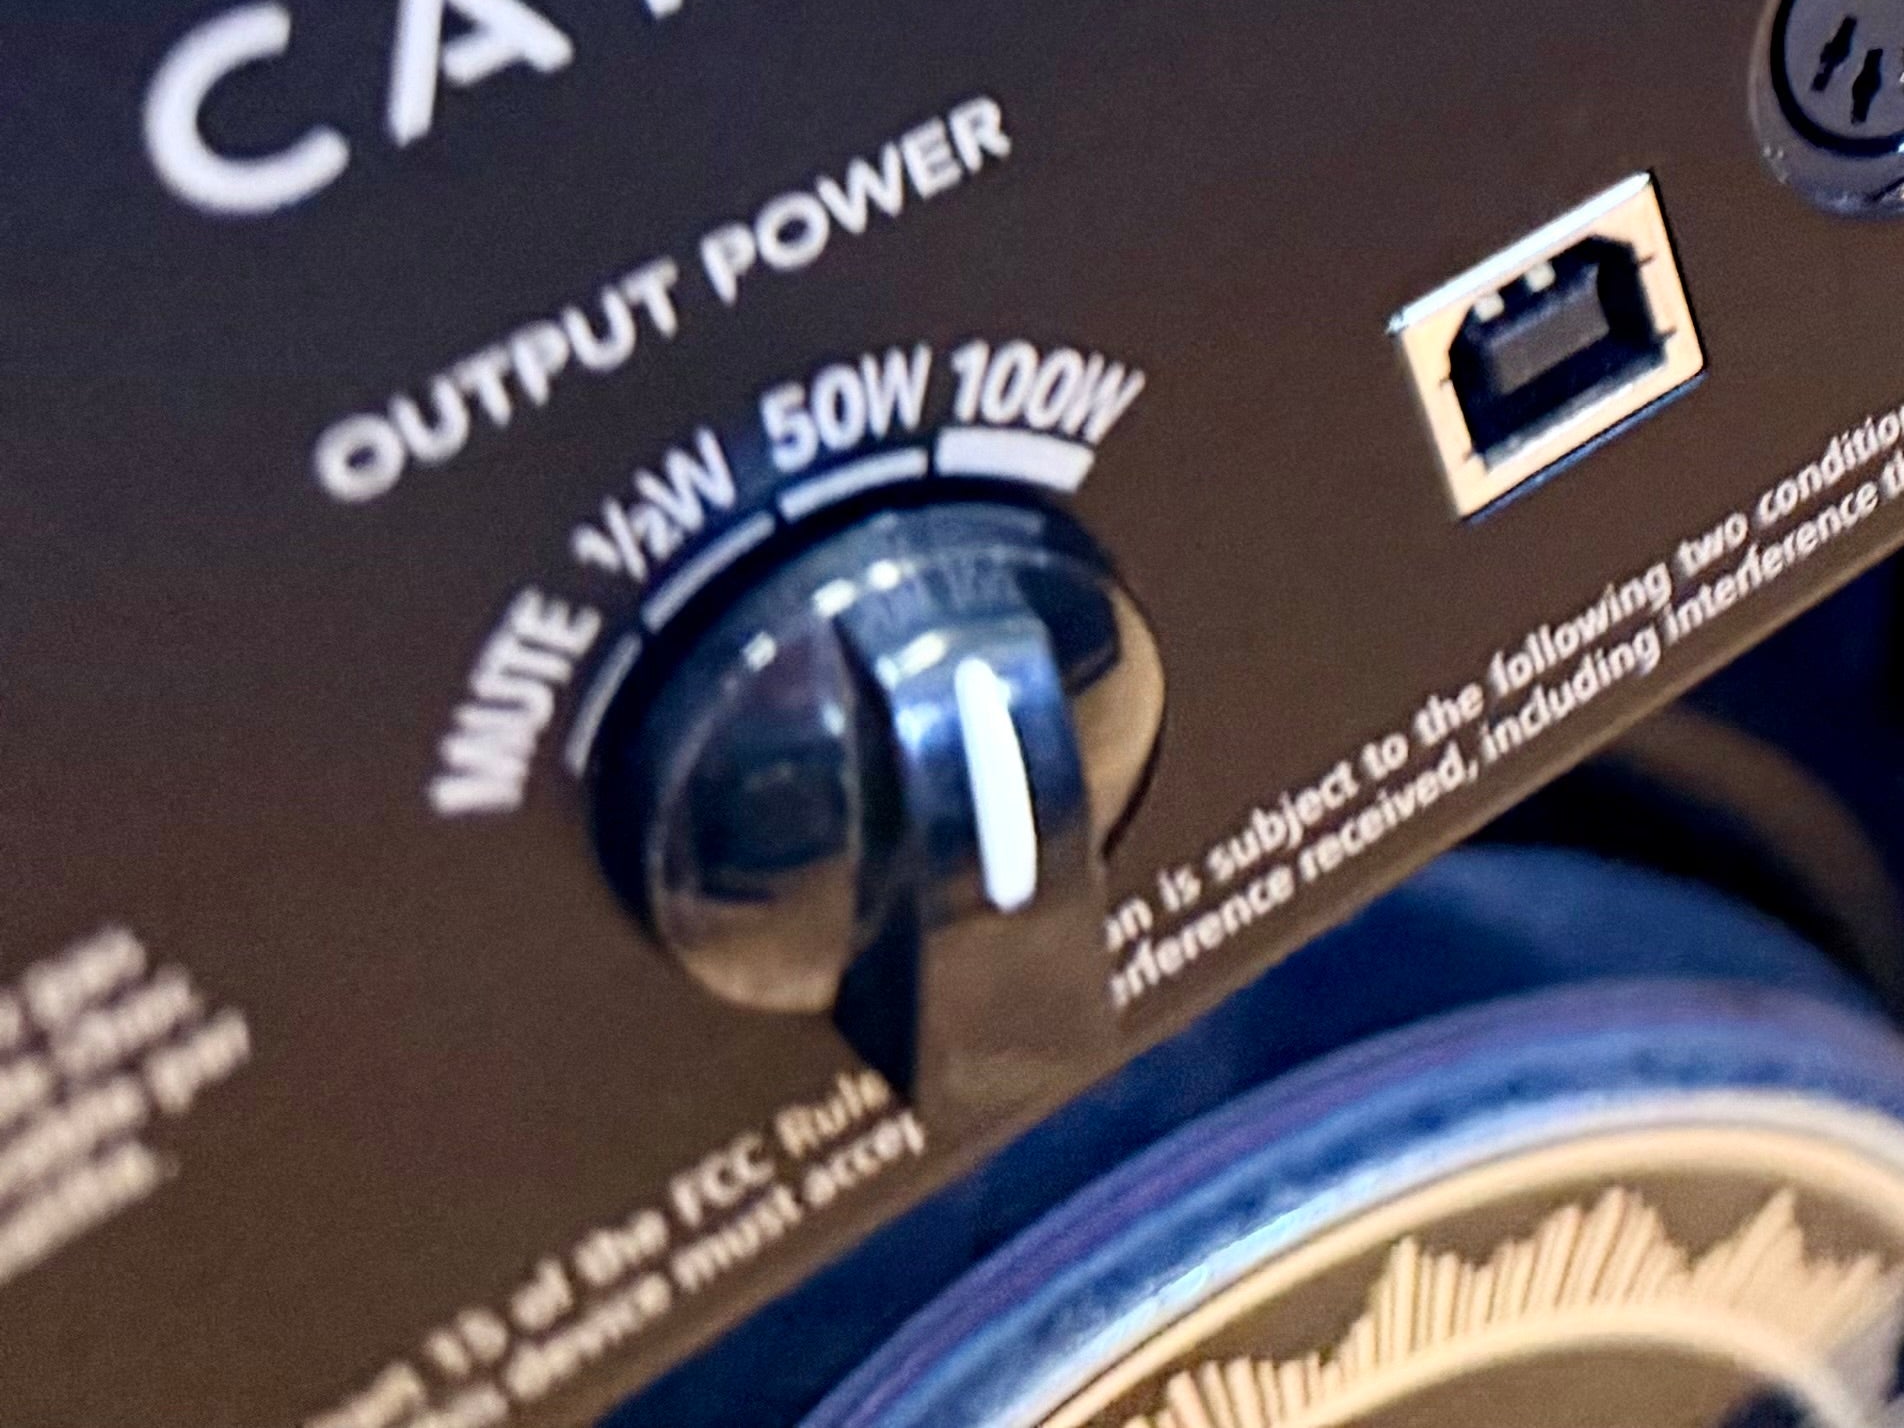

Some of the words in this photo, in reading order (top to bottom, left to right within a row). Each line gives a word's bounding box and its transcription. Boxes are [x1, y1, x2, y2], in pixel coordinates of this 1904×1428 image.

[315, 255, 679, 502] OUTPUT
[700, 95, 1013, 306] POWER
[761, 344, 933, 472] 50W
[950, 339, 1146, 445] 100W
[430, 587, 600, 814] MUTE
[1298, 742, 1481, 883] received,
[1480, 621, 1663, 764] including
[1661, 469, 1879, 641] interference
[670, 1130, 776, 1228] FCC
[1157, 866, 1201, 914] is
[1207, 761, 1358, 884] subject
[1363, 732, 1410, 782] to
[1413, 681, 1485, 740] the
[1488, 562, 1672, 701] following
[1677, 509, 1749, 573] two
